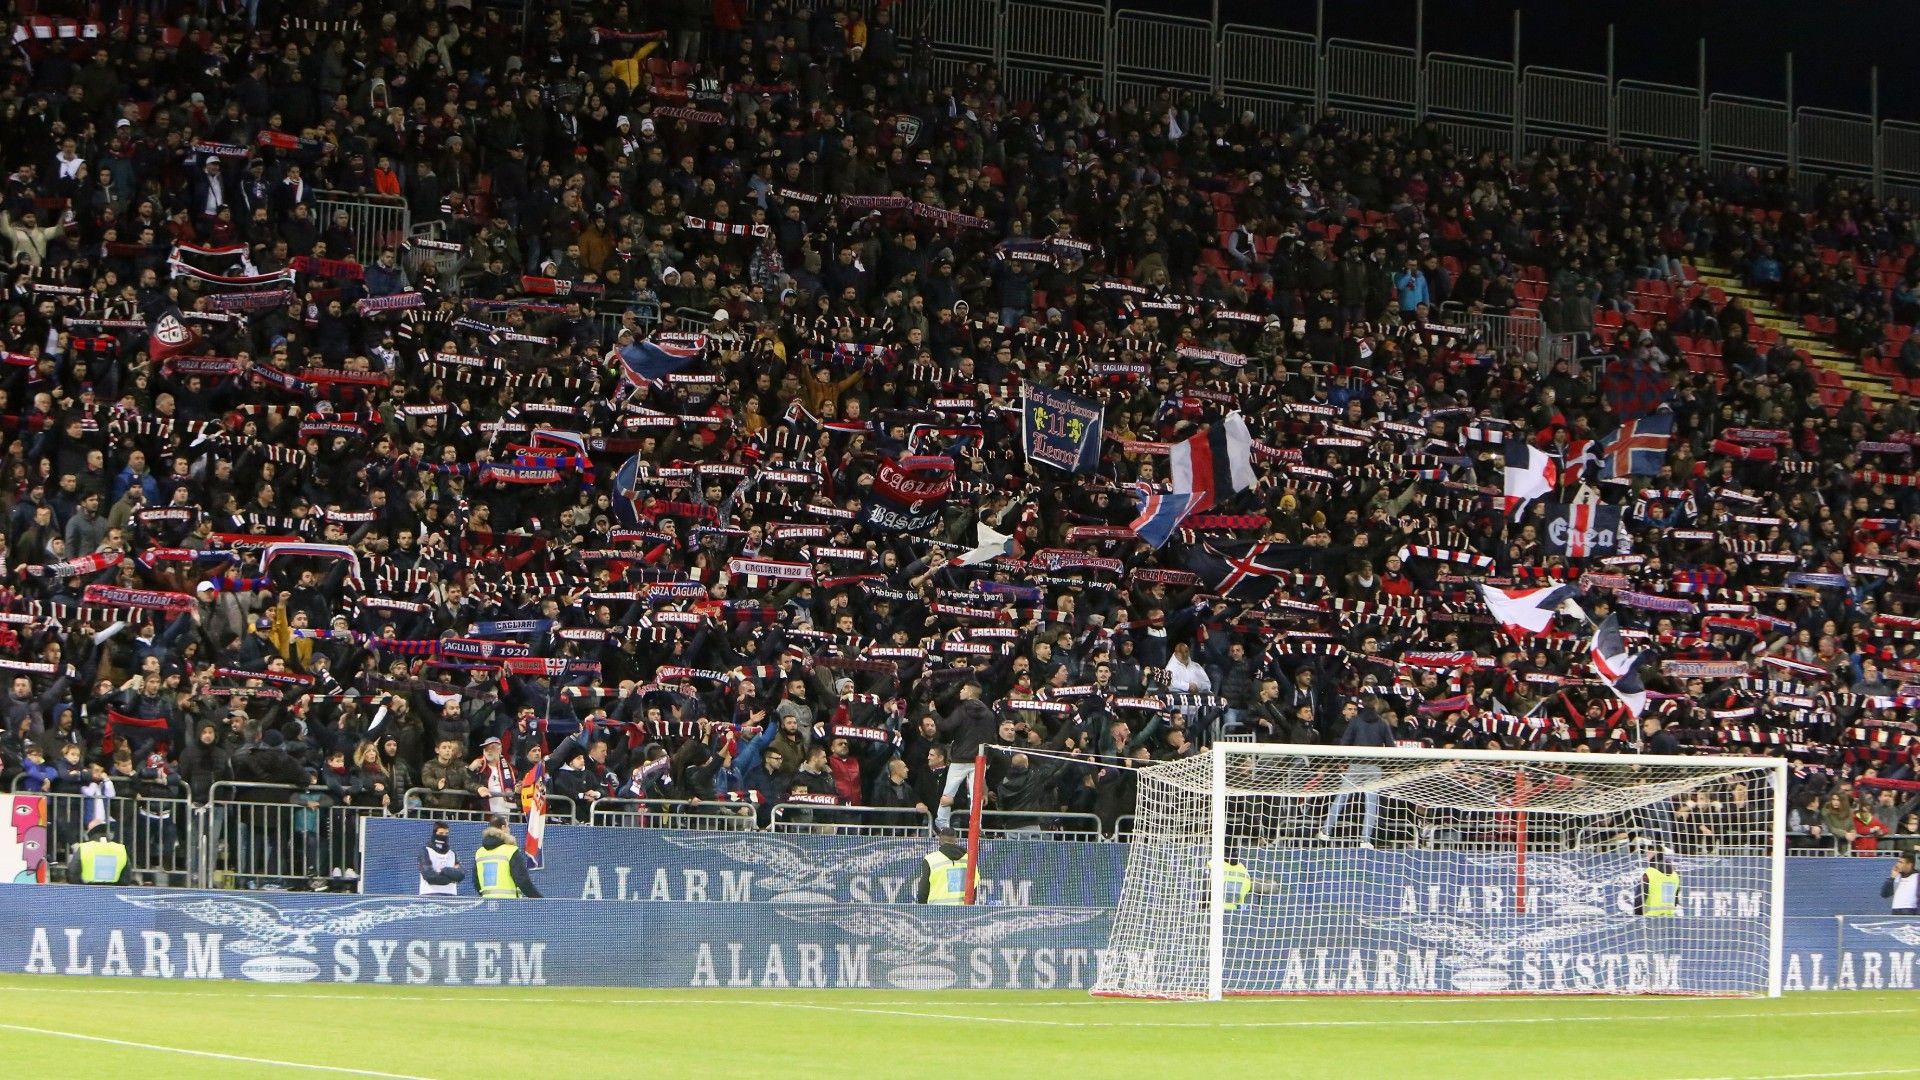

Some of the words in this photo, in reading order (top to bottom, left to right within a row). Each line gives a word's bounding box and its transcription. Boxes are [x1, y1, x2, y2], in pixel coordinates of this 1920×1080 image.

[781, 189, 817, 203] CAGLIARI
[1054, 238, 1092, 251] CAGLIARI
[1012, 252, 1050, 262] CAGLIARI
[1105, 282, 1146, 293] CAGLIARI
[1142, 302, 1180, 310] CAGLIARI
[1216, 312, 1260, 322] CAGLIARI
[1425, 323, 1466, 334] CAGLIARI
[505, 333, 547, 344] CAGLIARI
[437, 353, 483, 367] CAGLIARI
[177, 361, 198, 369] FORZA
[200, 362, 233, 371] CAGLIARI
[1131, 365, 1145, 373] 1920
[525, 403, 572, 413] CAGLIARI
[936, 399, 974, 408] CAGLIARI
[405, 405, 447, 415] CAGLIARI
[1291, 404, 1333, 415] CAGLIARI
[627, 417, 674, 427] CAGLIARI
[1048, 413, 1066, 438] 11
[331, 424, 355, 433] CALCIO
[1317, 438, 1361, 447] CAGLIARI
[1033, 432, 1080, 466] Leoni
[492, 467, 516, 478] FORZA
[519, 469, 556, 479] CAGLIARI
[700, 466, 745, 475] CAGLIARI
[141, 510, 189, 520] CAGLIARI
[327, 511, 374, 521] CAGLIARI
[809, 505, 852, 518] CAGLIARI
[612, 530, 644, 538] CAGLIARI
[646, 532, 671, 541] CALCIO
[779, 529, 822, 537] CAGLIARI
[1548, 517, 1614, 548] Enea
[816, 548, 864, 560] CAGLIARI
[745, 563, 781, 575] CAGLIARI
[784, 566, 801, 575] 1920
[102, 590, 128, 601] FORZA
[131, 594, 171, 606] CAGLIARI
[671, 587, 705, 598] CAGLIARI
[871, 586, 903, 599] Febbraio
[906, 590, 922, 600] 198
[947, 589, 979, 600] Febbraio
[367, 598, 418, 612] CAGLIARI
[937, 604, 996, 619] CAGLIARI
[658, 612, 698, 623] CAGLIARI
[496, 620, 535, 630] CAGLIARI
[561, 630, 605, 640] CAGLIARI
[971, 628, 1016, 637] CAGLIARI
[500, 647, 529, 656] 1920
[872, 648, 923, 658] CAGLIARI
[945, 642, 990, 653] CAGLIARI
[268, 674, 296, 683] CALCIO
[1054, 687, 1093, 696] CAGLIARI
[1012, 701, 1066, 711] CAGLIARI
[1117, 699, 1160, 708] CAGLIARI
[835, 728, 886, 740] CAGLIARI
[582, 866, 754, 900] ALARM
[849, 876, 1032, 906] SYEM
[1401, 886, 1541, 913] ALARM
[1617, 890, 1763, 917] STEM
[25, 927, 223, 979] ALARM
[333, 938, 547, 985] SYSTEM
[690, 943, 872, 988] ALARM
[969, 947, 1156, 990] SYSTEM
[1281, 948, 1438, 990] ALARM
[1521, 952, 1682, 990] SYSTEM
[1784, 952, 1913, 990] ALARM
